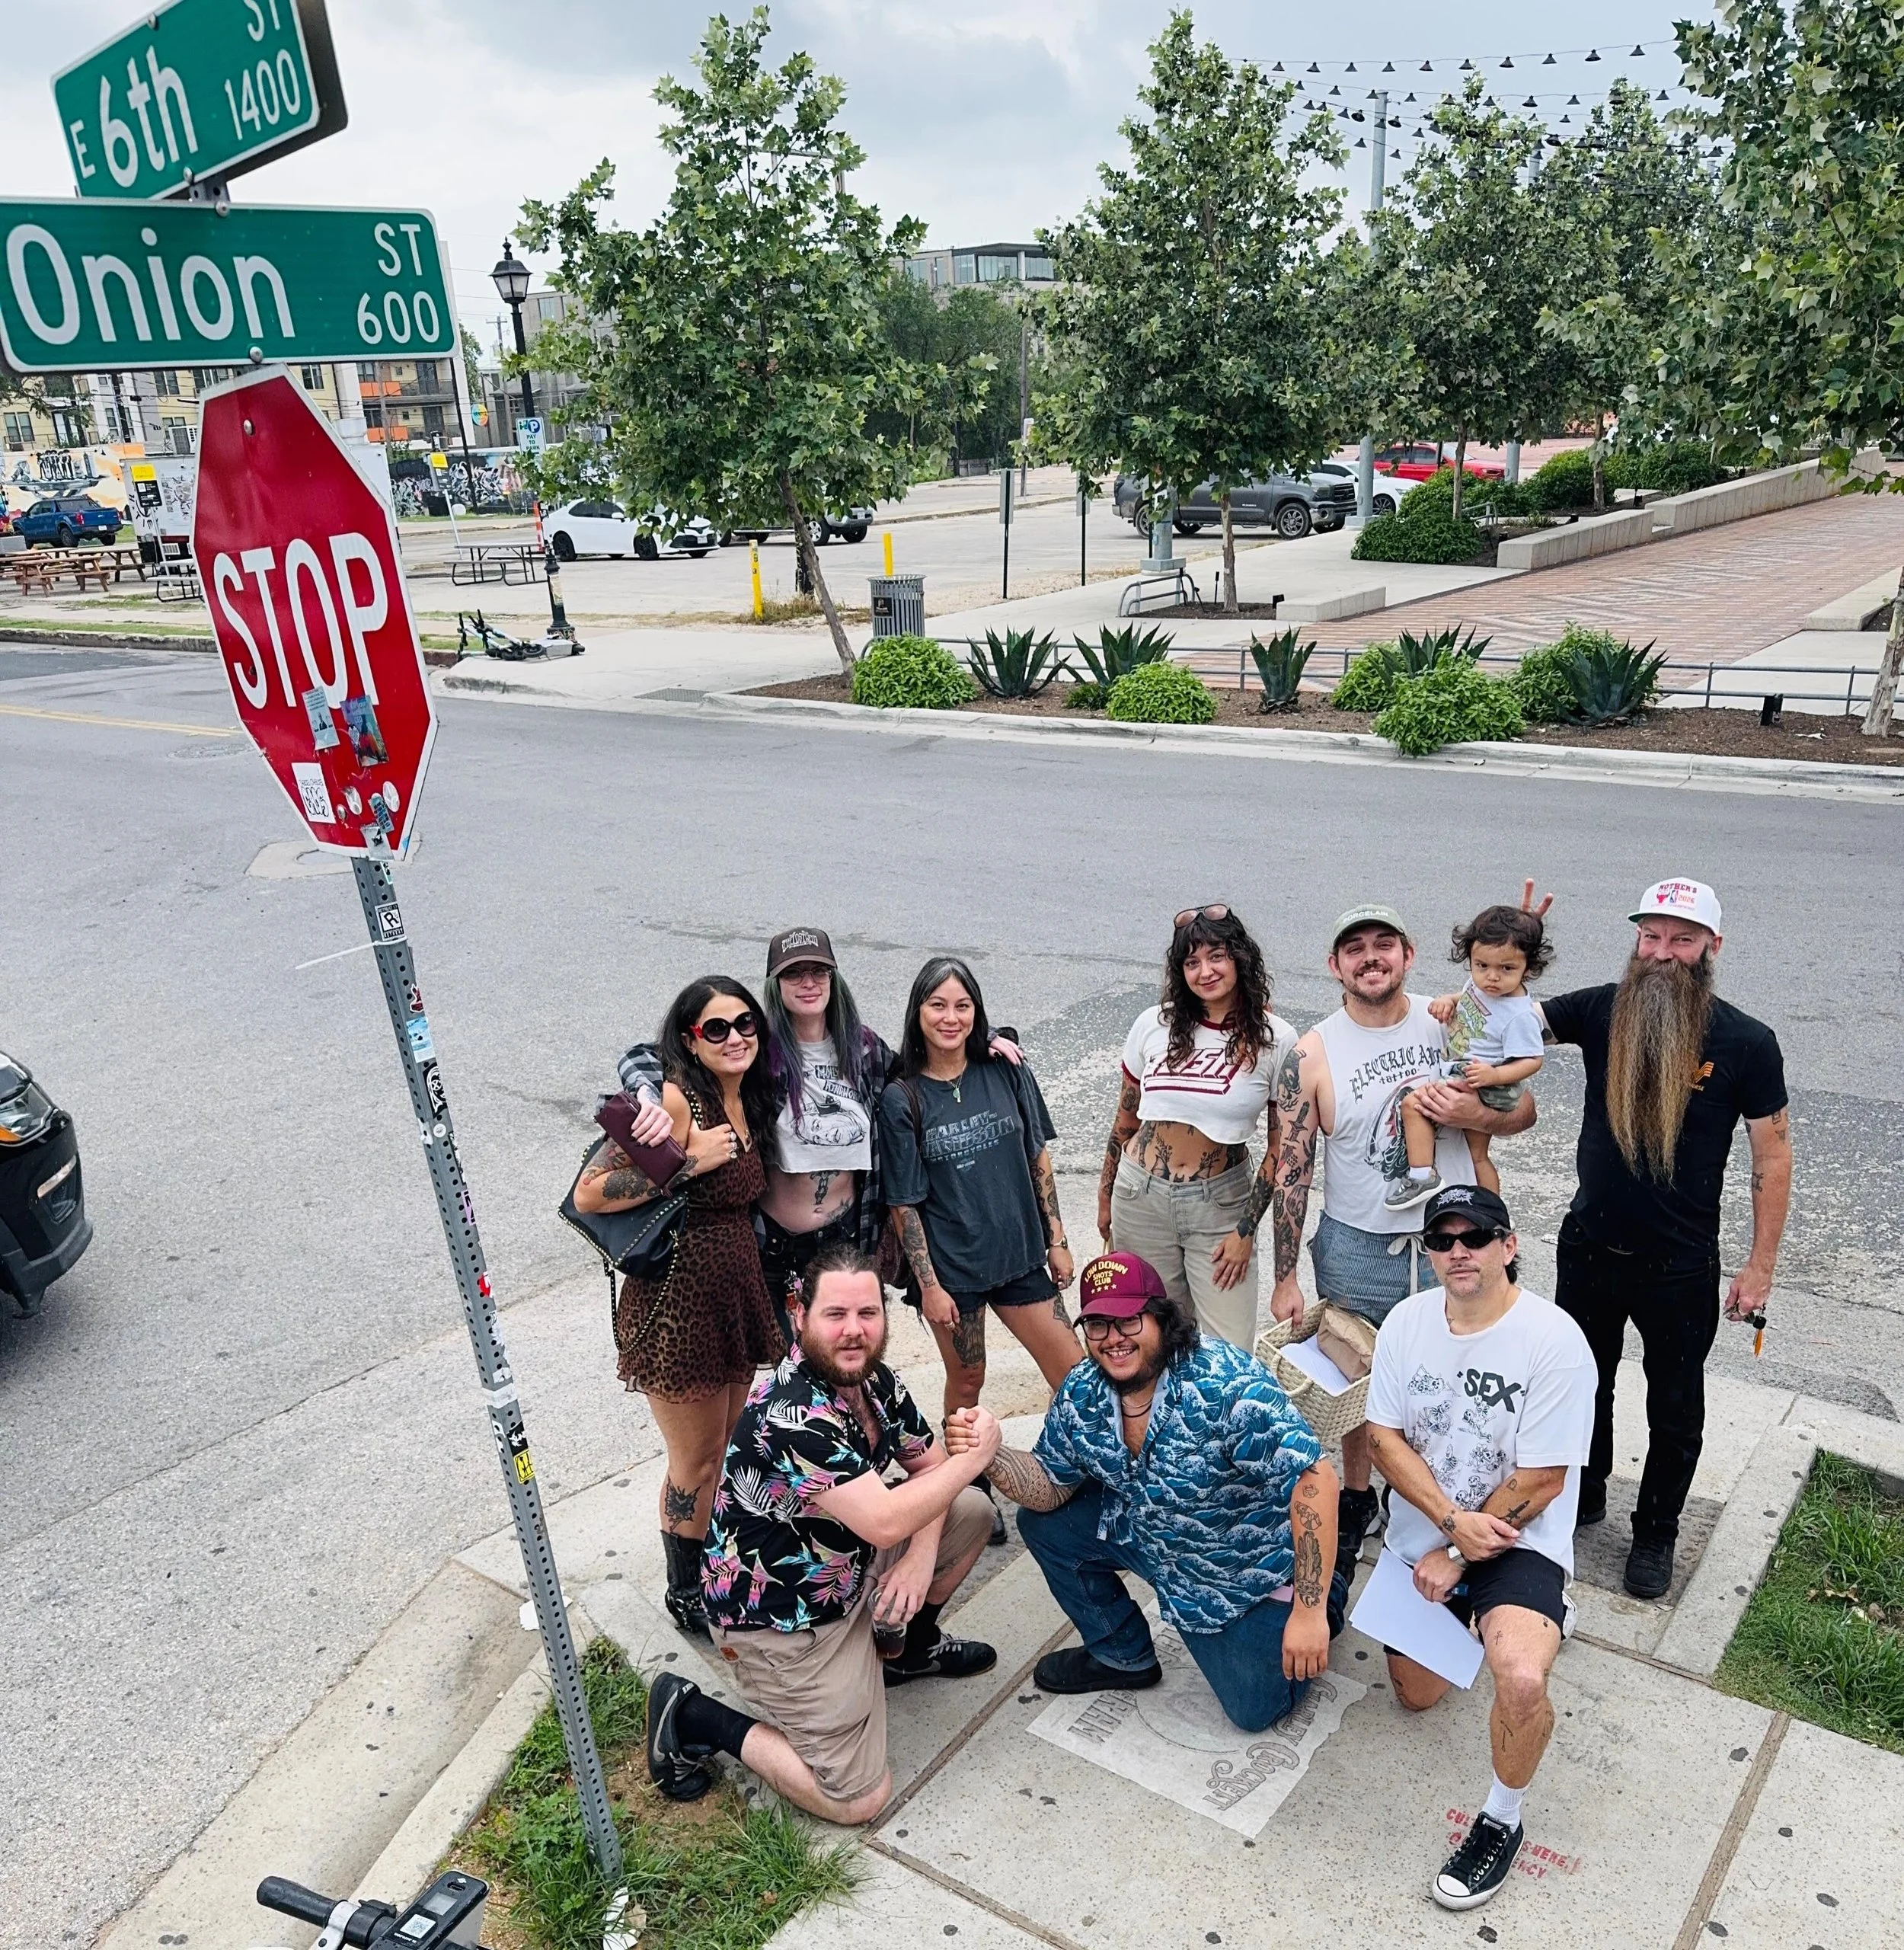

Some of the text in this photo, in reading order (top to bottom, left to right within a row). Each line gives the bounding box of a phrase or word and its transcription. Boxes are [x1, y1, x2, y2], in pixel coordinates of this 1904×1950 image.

[70, 44, 198, 188] E 6th
[224, 49, 302, 141] 1400
[6, 222, 423, 346] Onion ST
[356, 290, 440, 345] 600
[213, 532, 388, 709] STOP
[1658, 882, 1698, 893] MOTHER'S
[1343, 910, 1388, 923] PORCELAIN
[1350, 1045, 1416, 1104] ELECTRIC
[1085, 1261, 1128, 1283] LOW DOWN
[1092, 1270, 1113, 1281] SHOTS
[1094, 1277, 1111, 1287] CLUB
[1203, 1741, 1301, 1811] CROCKETT
